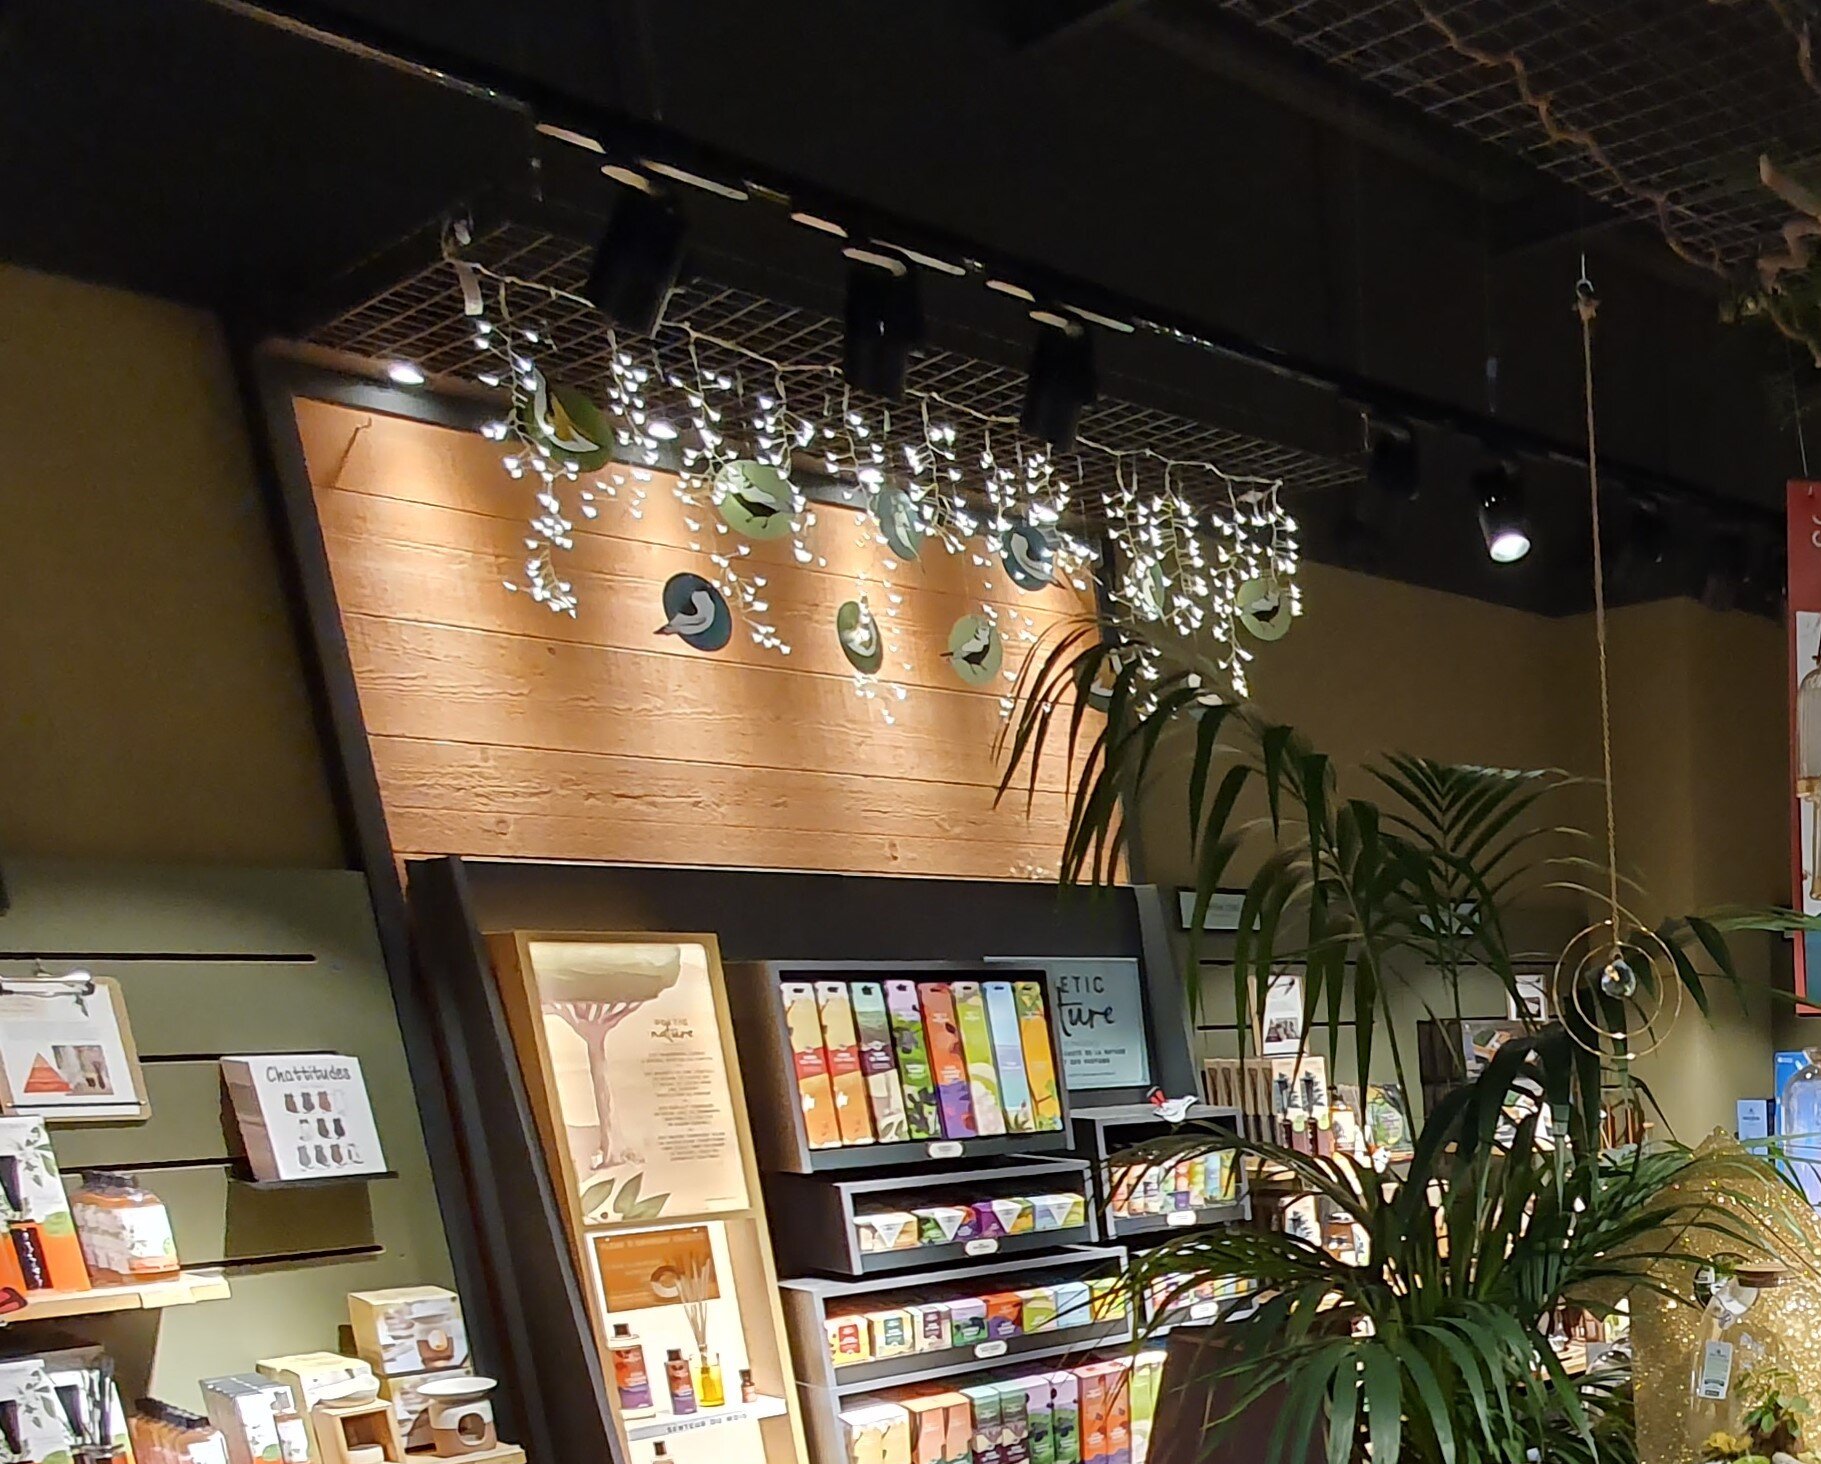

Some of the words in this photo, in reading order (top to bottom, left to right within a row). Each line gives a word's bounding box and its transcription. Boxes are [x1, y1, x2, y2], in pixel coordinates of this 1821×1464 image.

[1060, 976, 1105, 994] ETIC
[1057, 986, 1115, 1037] ture
[266, 1065, 351, 1082] Chattitudes
